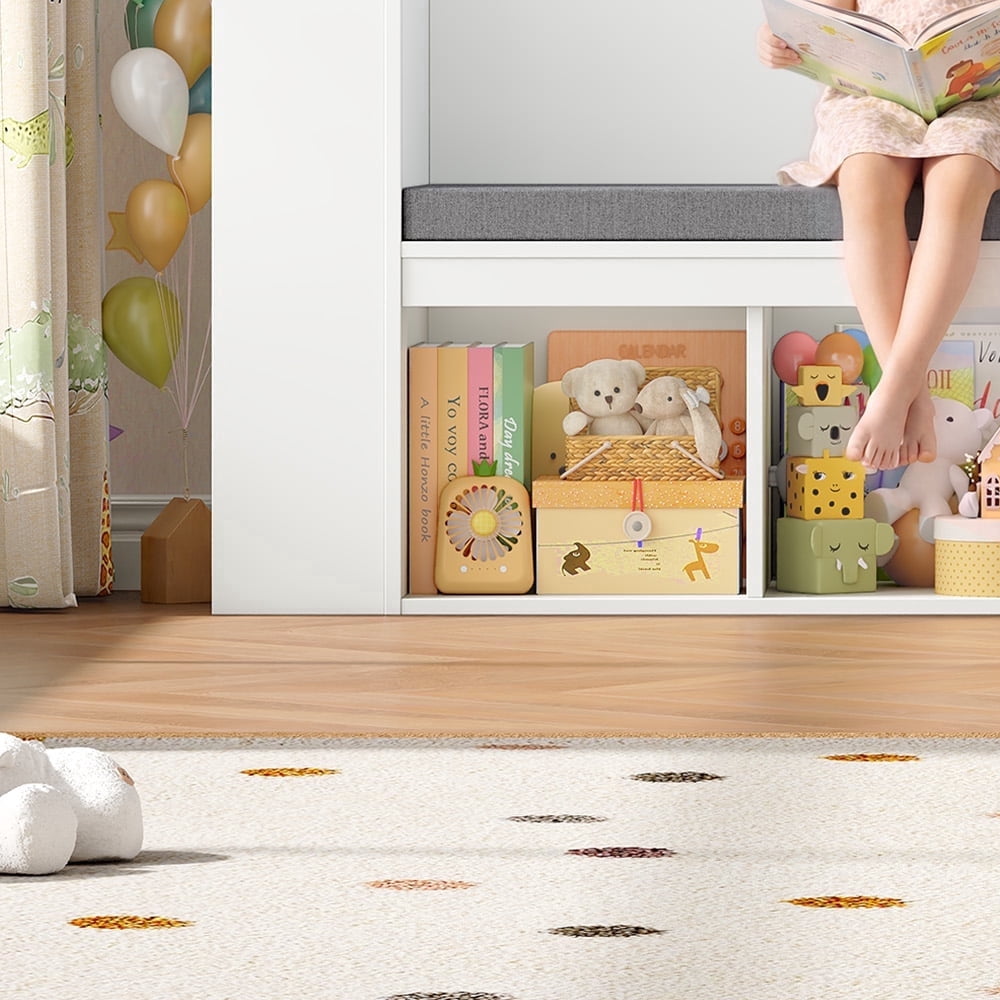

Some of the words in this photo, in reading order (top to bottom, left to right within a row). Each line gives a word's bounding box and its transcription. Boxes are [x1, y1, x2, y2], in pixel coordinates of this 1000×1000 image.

[420, 396, 430, 409] A
[447, 395, 461, 418] Yo
[478, 386, 490, 430] FLORA
[420, 415, 431, 450] little
[443, 425, 458, 456] voy
[498, 416, 518, 449] Day
[734, 420, 741, 432] 8
[478, 432, 491, 460] and
[420, 456, 430, 502] Honzo
[420, 509, 432, 543] book
